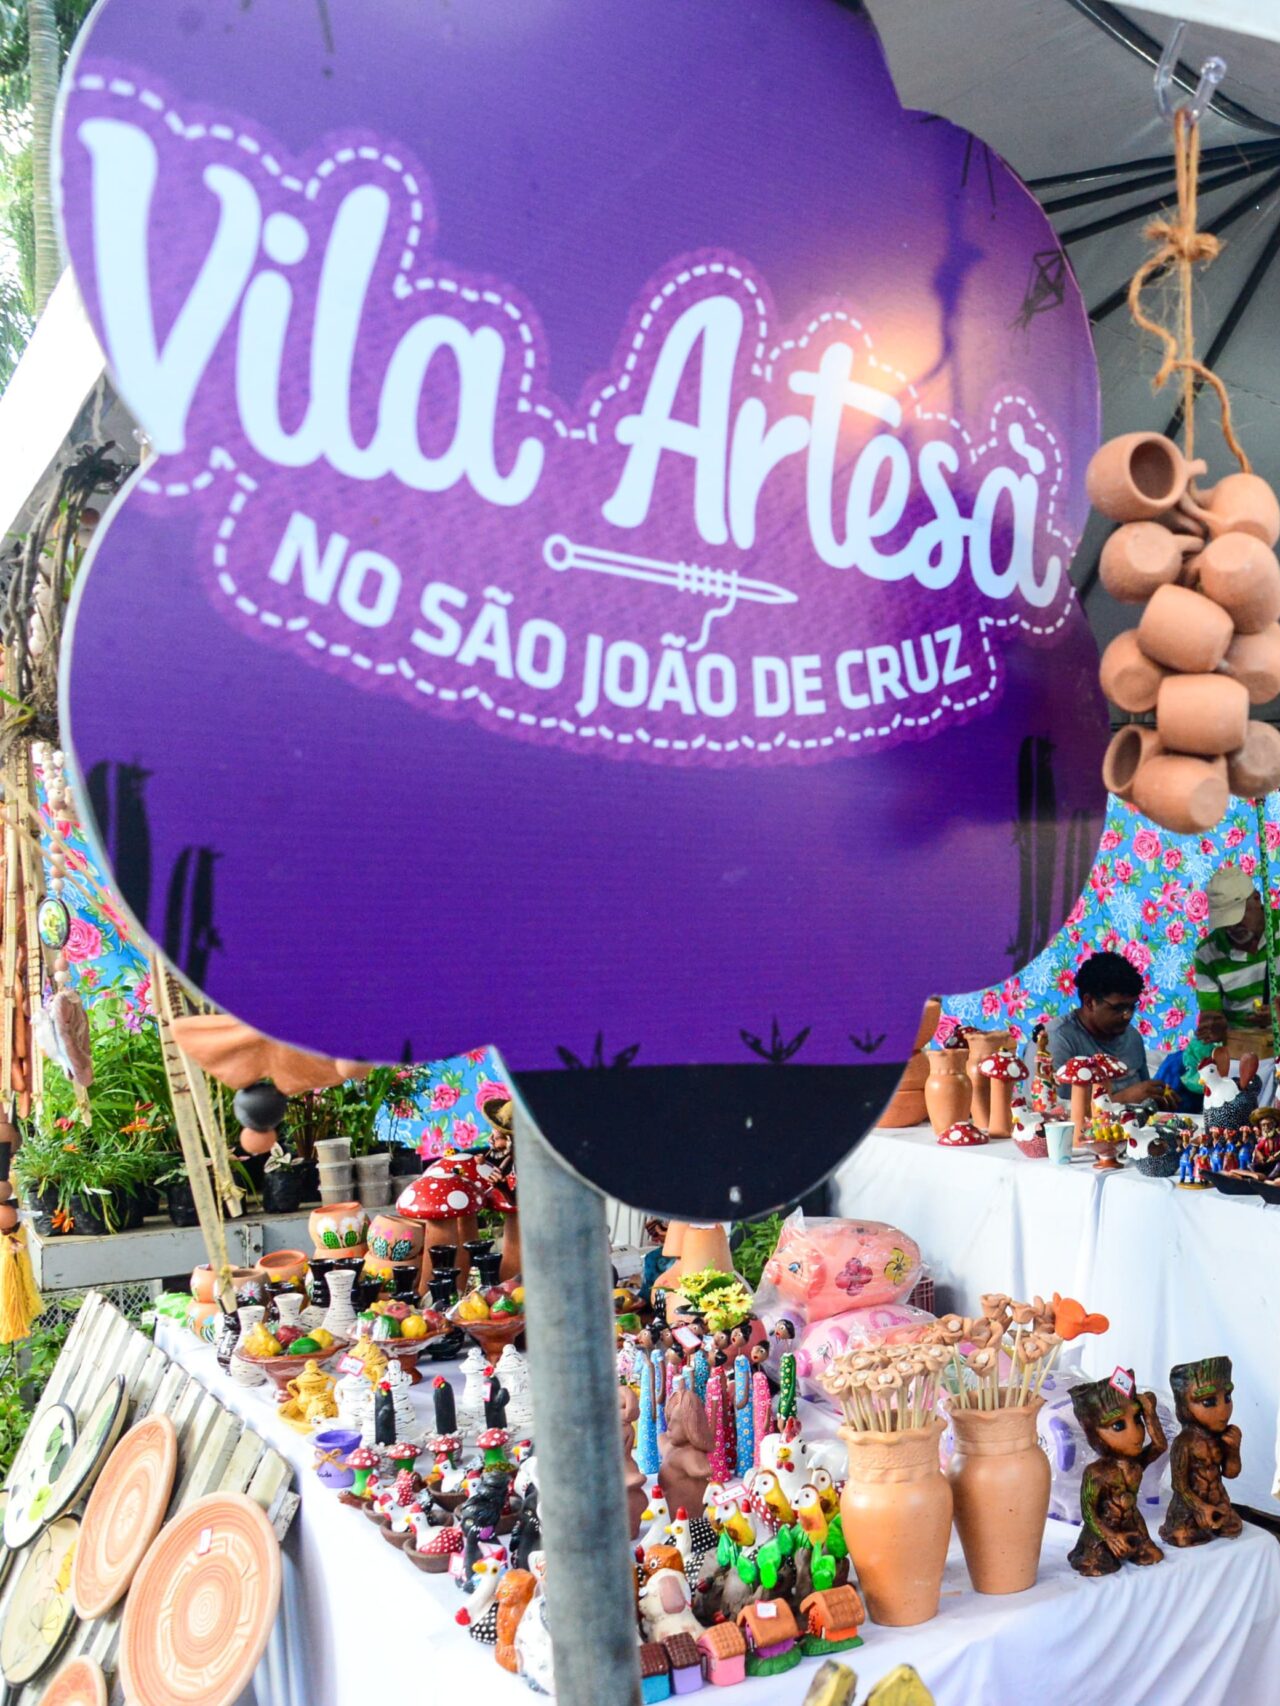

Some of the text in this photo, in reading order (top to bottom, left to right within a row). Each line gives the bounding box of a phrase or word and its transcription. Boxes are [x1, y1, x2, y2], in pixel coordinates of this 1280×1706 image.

[77, 117, 1062, 608] Vila Artesã
[268, 510, 972, 719] NO SÃO JOÃO DE CRUZ
